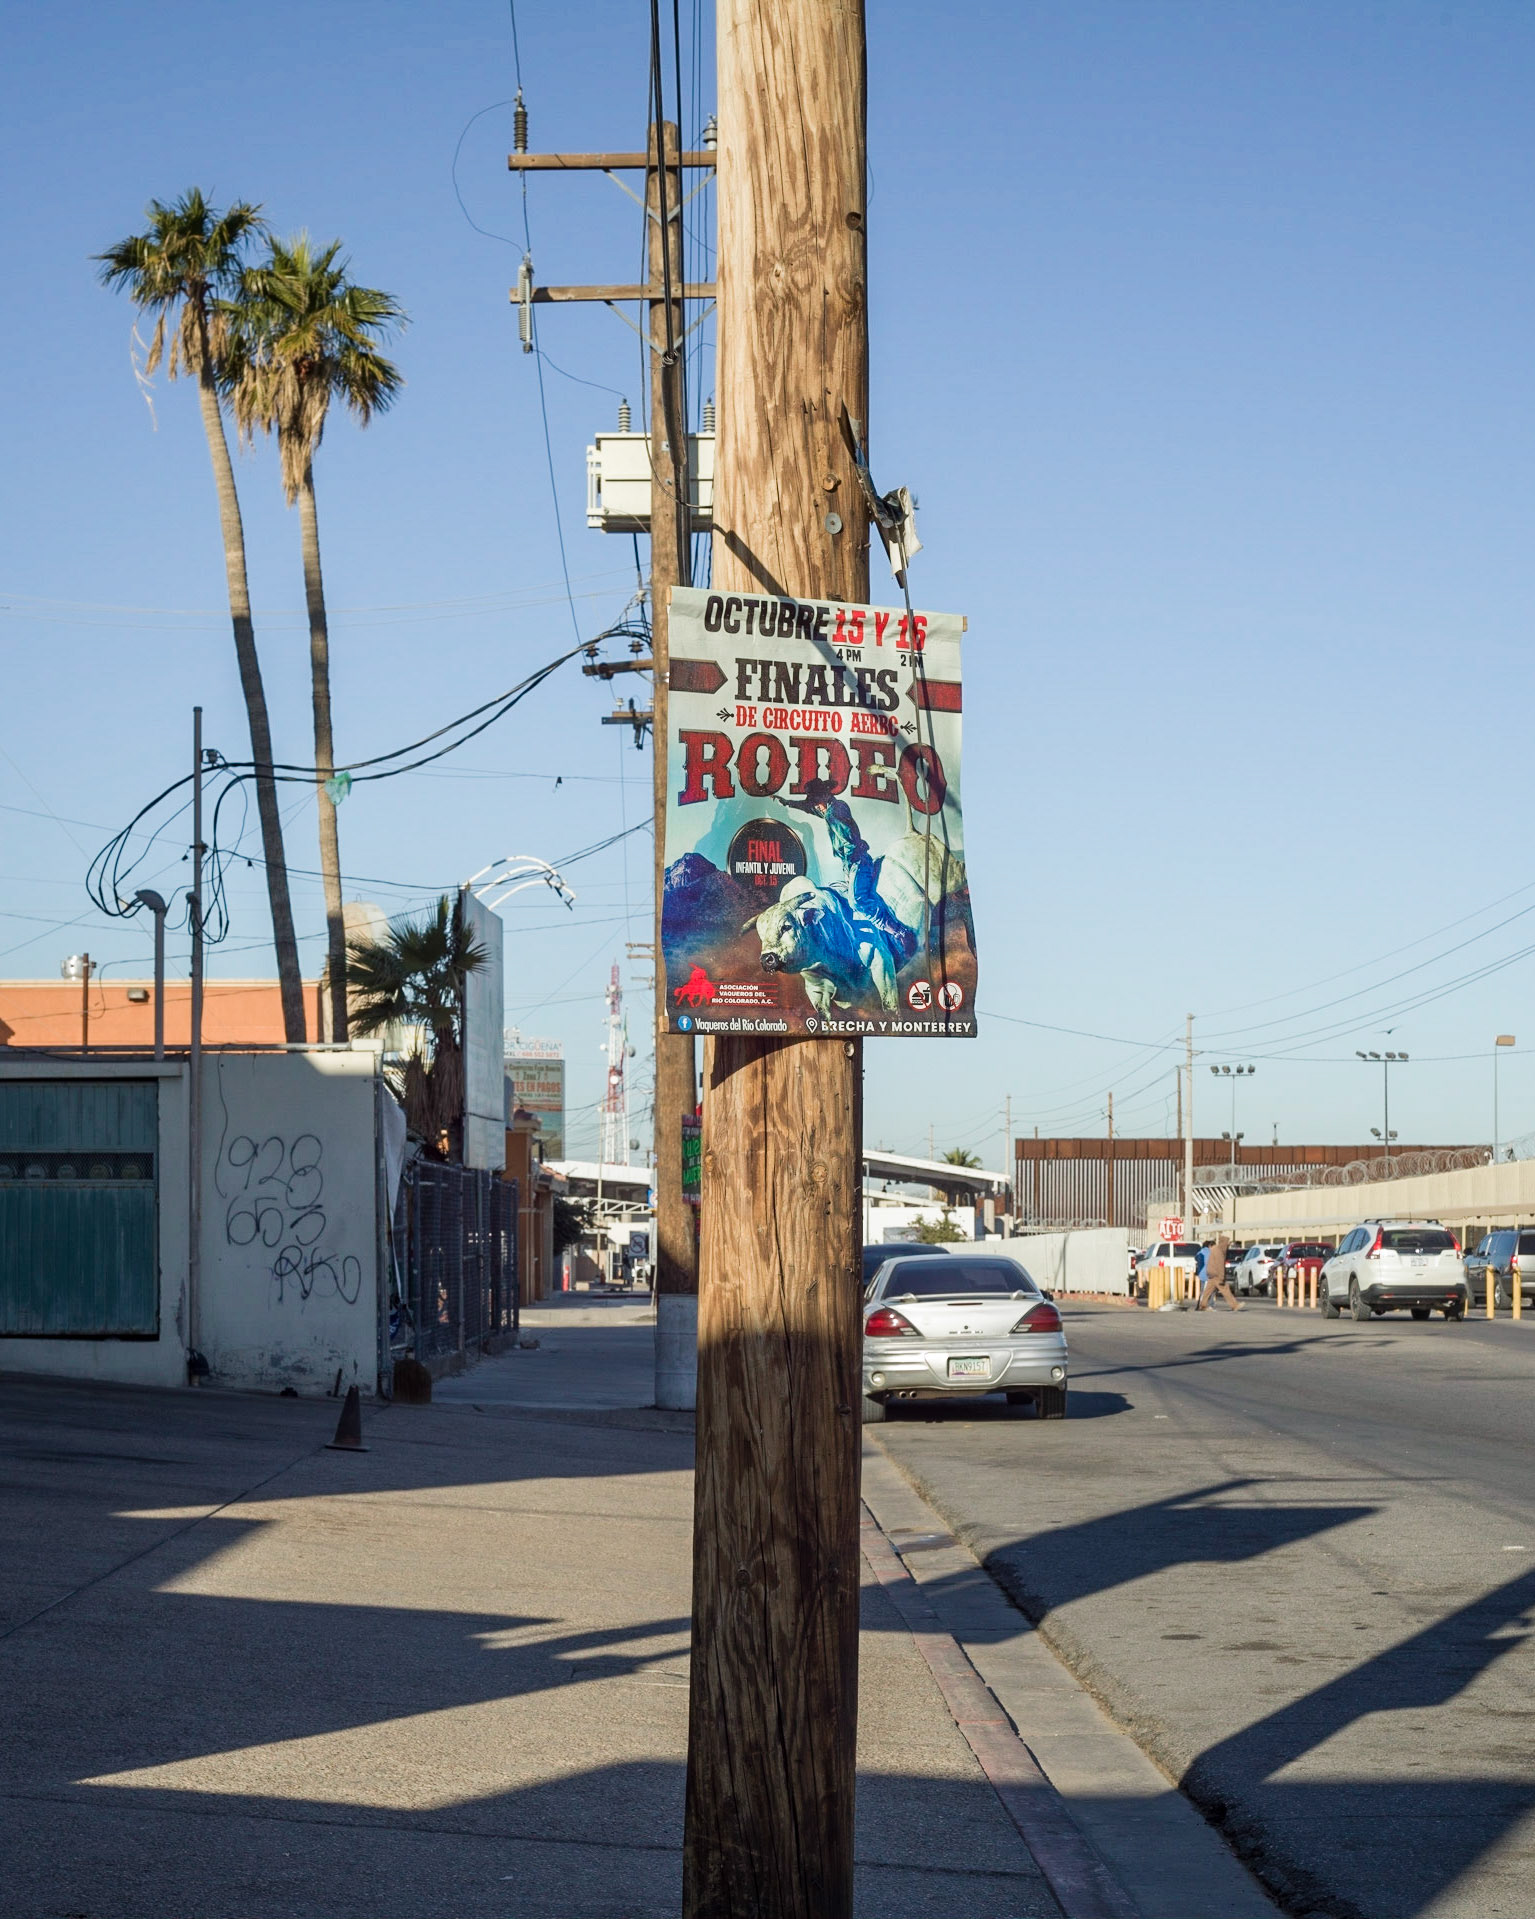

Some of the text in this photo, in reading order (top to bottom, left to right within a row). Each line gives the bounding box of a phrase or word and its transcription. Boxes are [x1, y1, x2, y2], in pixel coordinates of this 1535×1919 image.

[704, 595, 928, 651] OCTUBRE 15 Y 16
[836, 648, 862, 662] 4 PM
[900, 654, 907, 666] 2
[734, 657, 900, 712] FINALES
[735, 705, 757, 728] DE
[762, 706, 843, 733] CIRCUITO
[678, 728, 947, 816] RODEO
[747, 839, 784, 863] FINAL
[735, 861, 796, 876] INFANTIL Y JUVENIL
[694, 1018, 729, 1032] Vaqueros
[730, 1018, 741, 1030] del
[755, 1019, 788, 1031] Colorado
[821, 1019, 972, 1033] BRECHA Y MONTERREY
[228, 1134, 323, 1210] 928
[1160, 1220, 1184, 1236] ALTO
